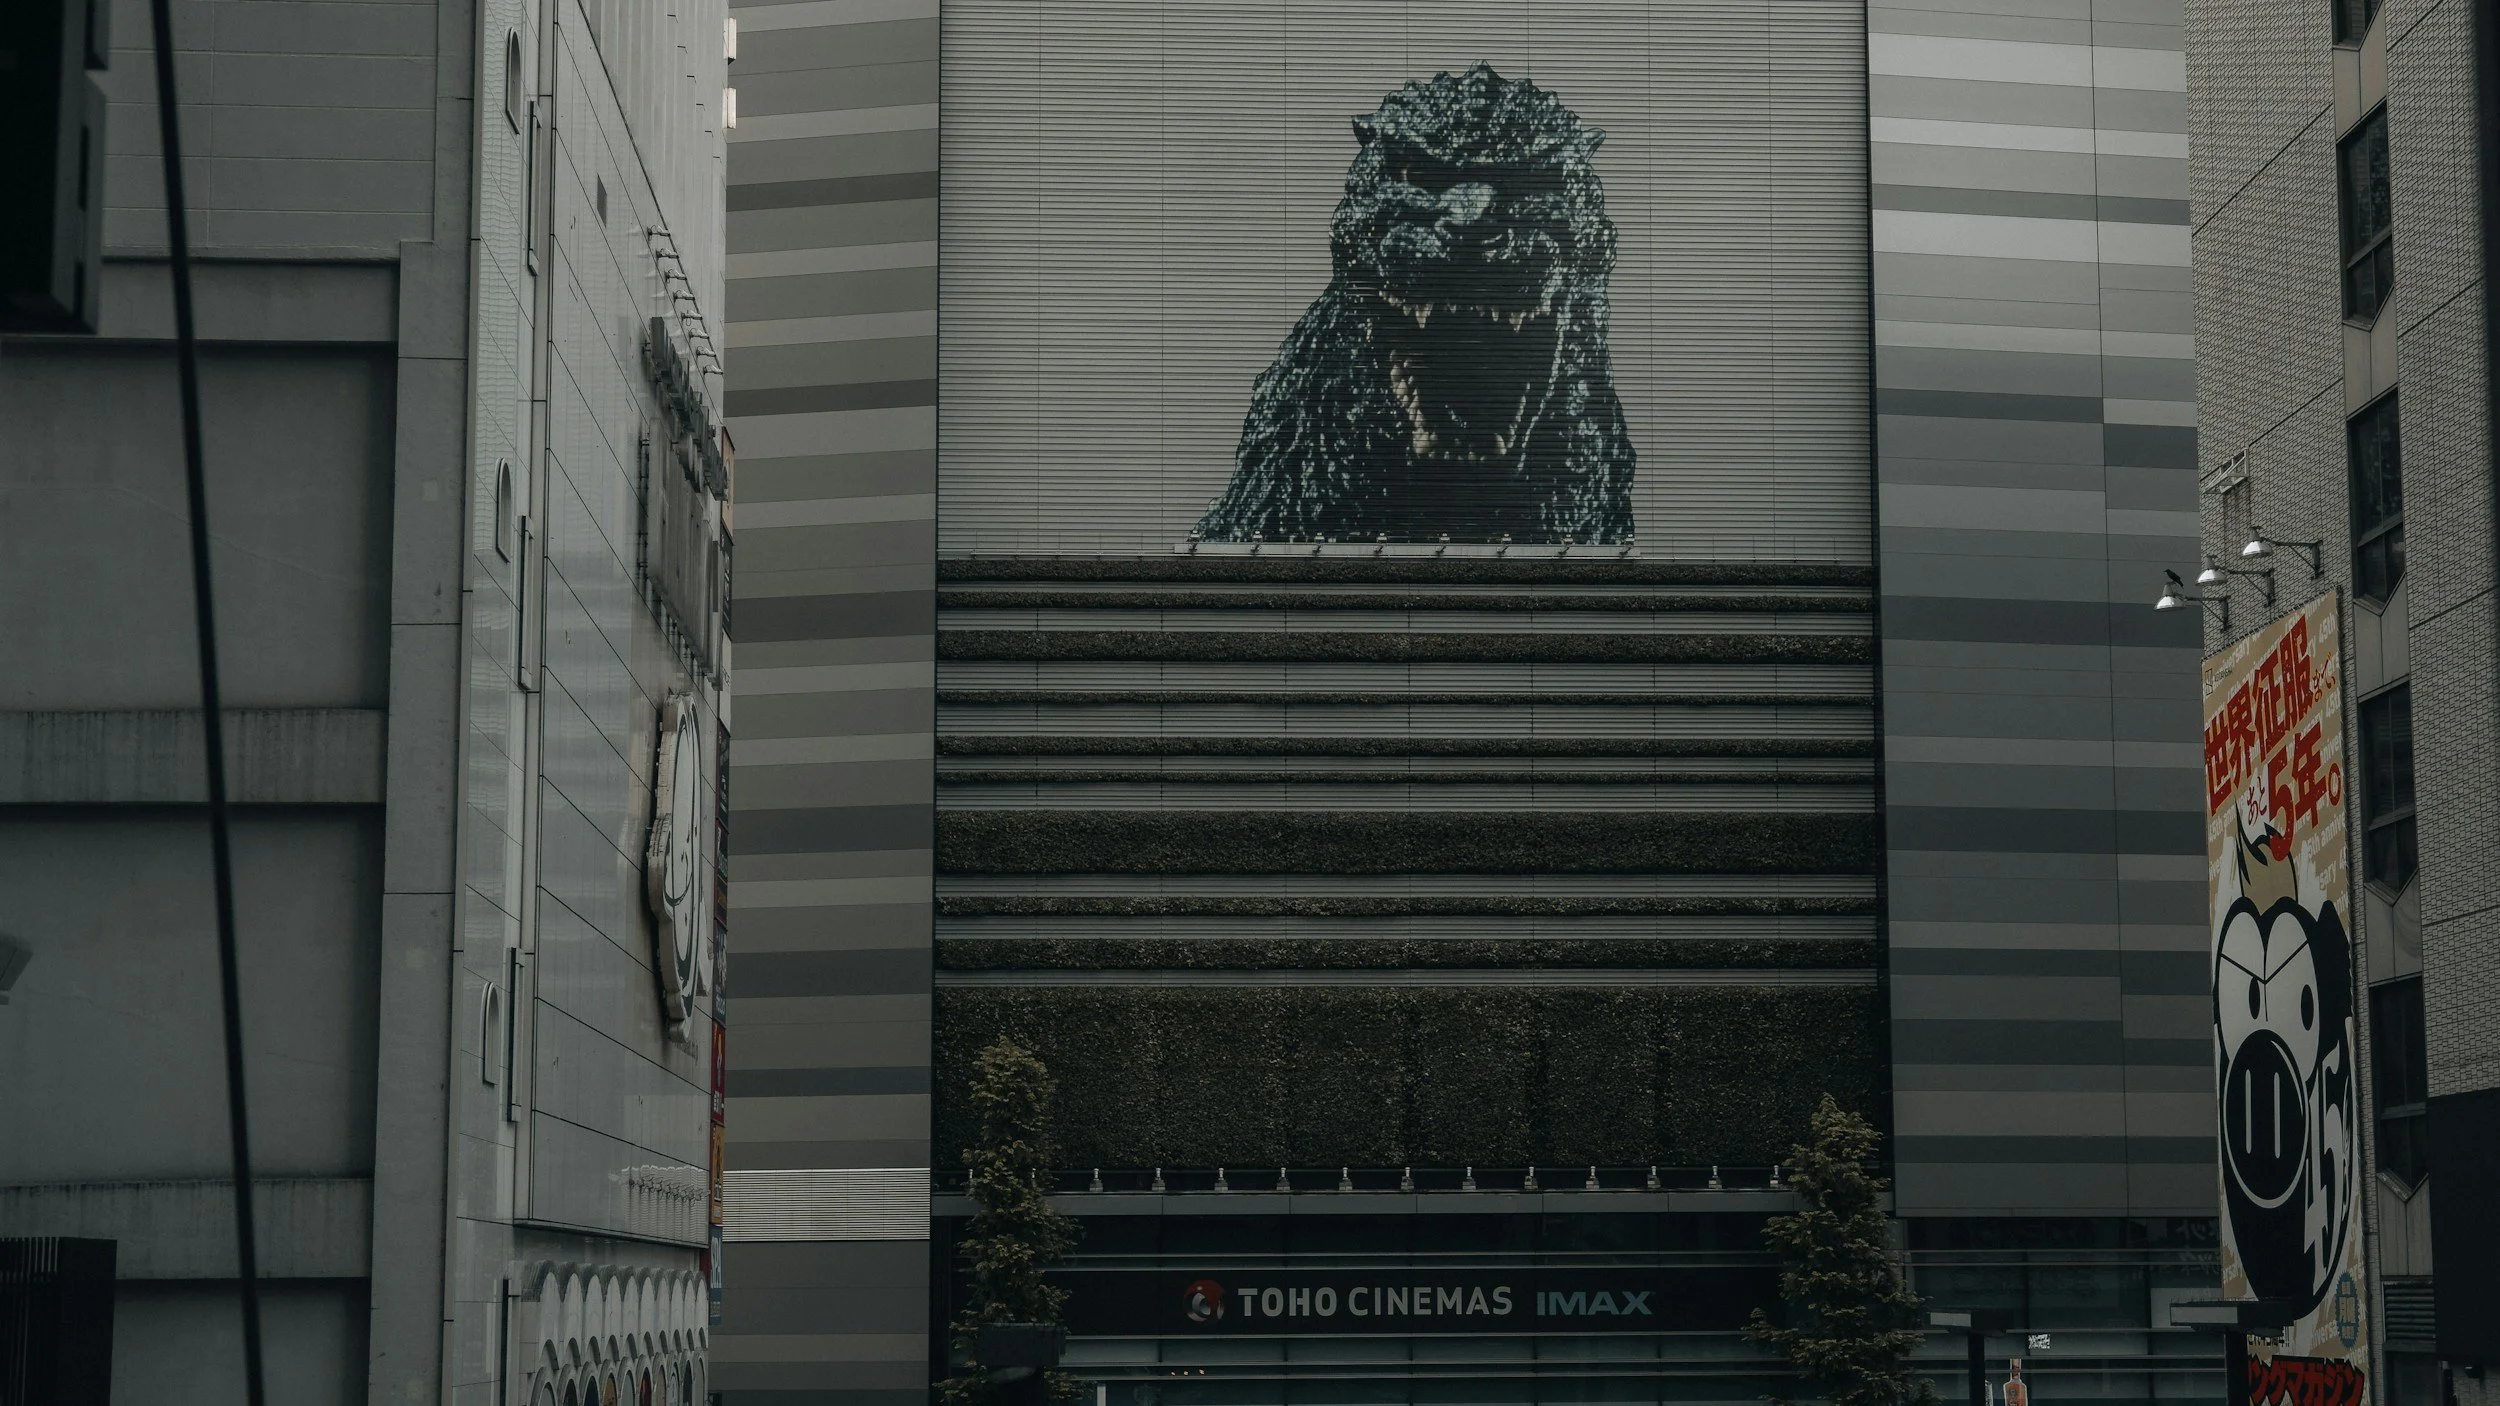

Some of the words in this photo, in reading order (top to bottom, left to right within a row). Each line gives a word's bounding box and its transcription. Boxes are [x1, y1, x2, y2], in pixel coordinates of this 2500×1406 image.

[1238, 1286, 1337, 1317] TOHO
[1347, 1286, 1513, 1316] CINEMAS
[1536, 1291, 1653, 1316] IMAX
[2247, 1358, 2364, 1406] ングマガジン
